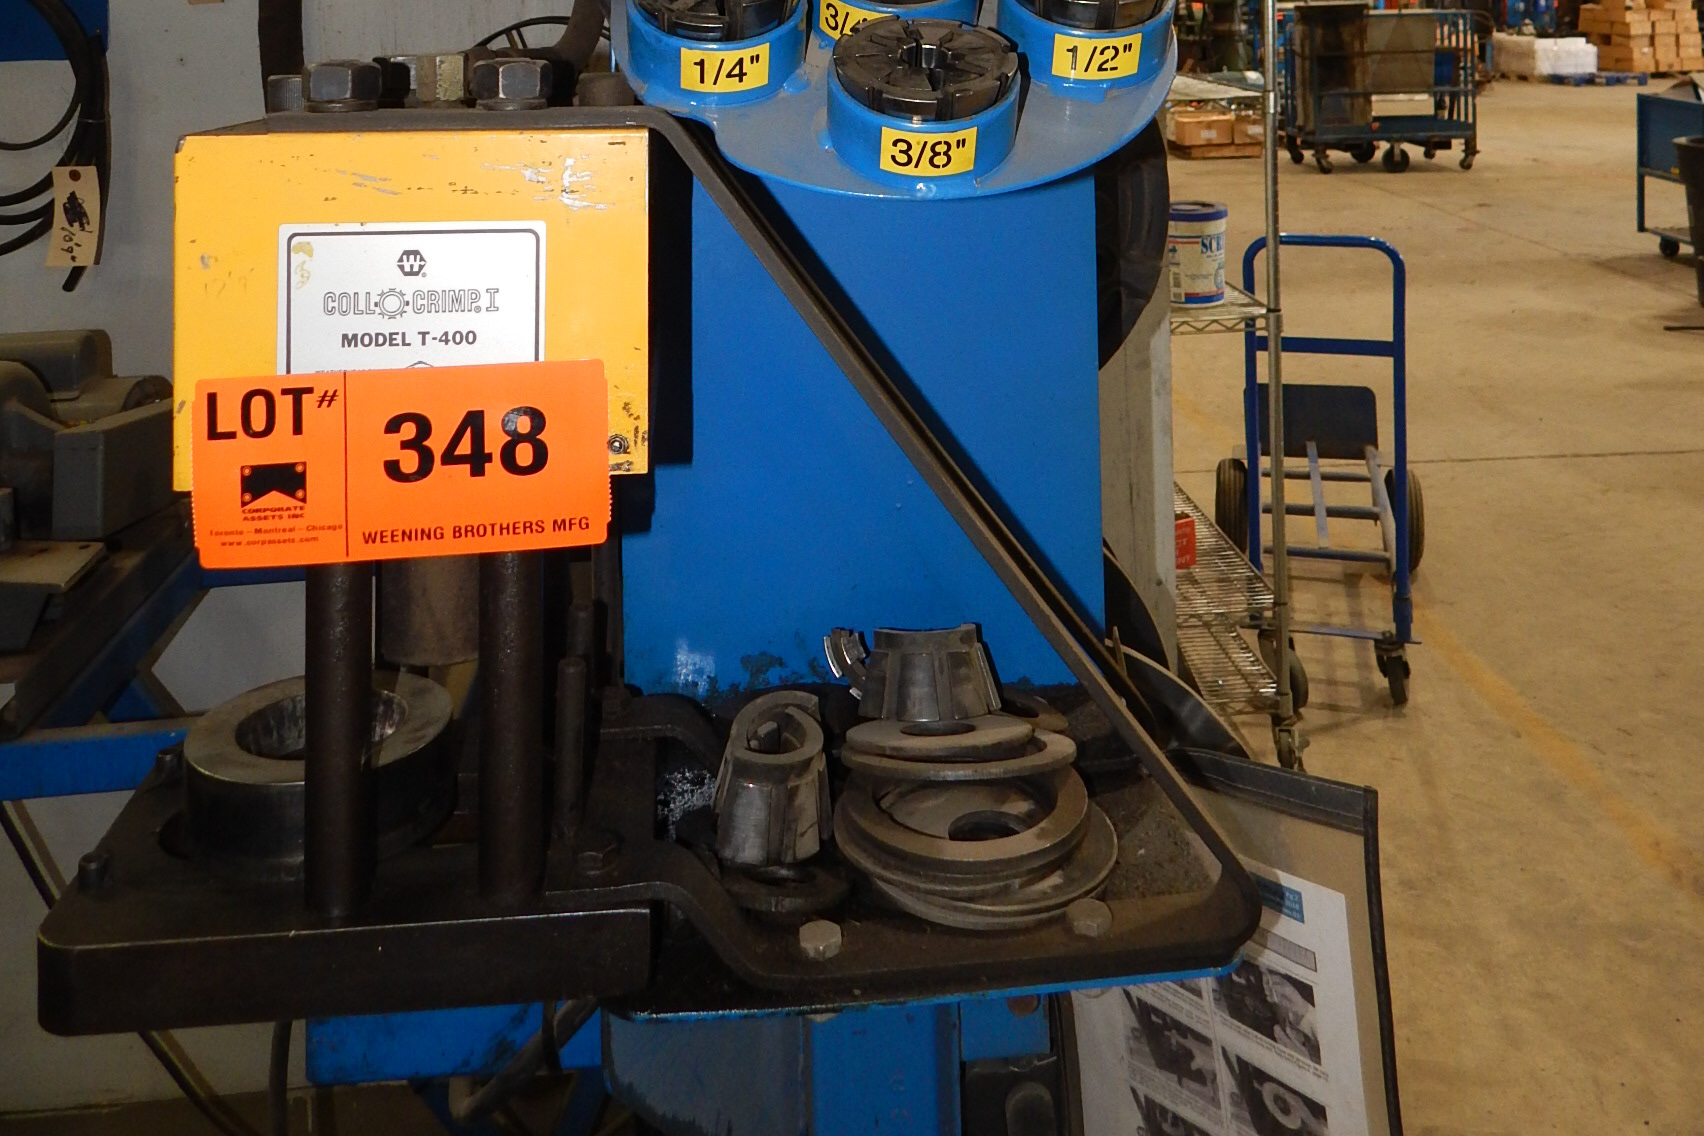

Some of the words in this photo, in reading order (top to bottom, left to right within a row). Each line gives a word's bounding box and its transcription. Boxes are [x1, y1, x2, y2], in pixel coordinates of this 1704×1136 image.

[693, 53, 760, 85] 1/4"
[1066, 43, 1133, 73] 1/2"
[891, 138, 967, 168] 3/8"
[341, 331, 411, 348] MODEL
[418, 330, 477, 346] T-400
[383, 405, 548, 483] 348
[241, 505, 305, 514] CORPORATE
[242, 514, 283, 522] ASSETS
[254, 526, 296, 535] Montreal
[306, 523, 343, 533] Chicago
[362, 526, 444, 545] WEENING
[452, 519, 545, 539] BROTHERS
[552, 516, 590, 533] MFG
